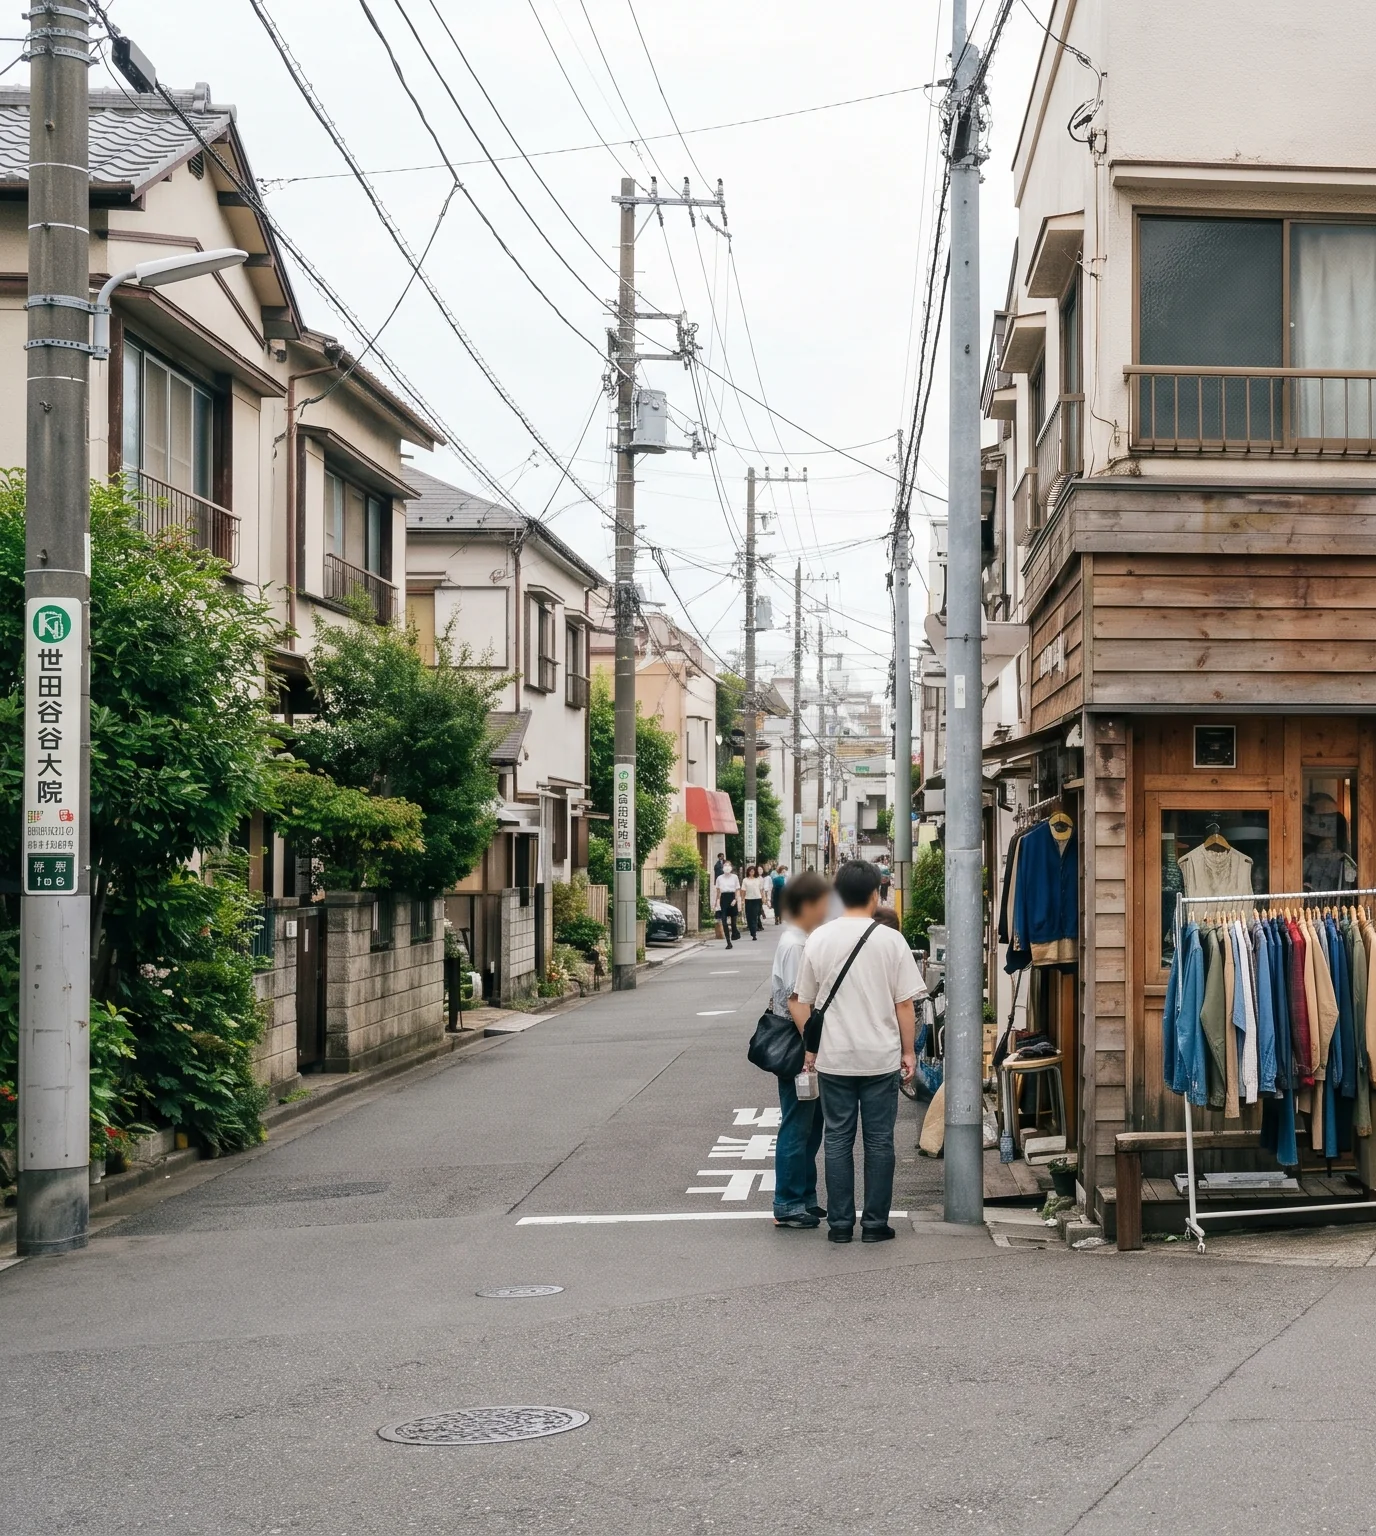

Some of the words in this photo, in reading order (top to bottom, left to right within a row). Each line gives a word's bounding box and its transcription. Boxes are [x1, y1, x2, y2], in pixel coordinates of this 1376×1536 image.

[37, 648, 63, 805] 世田谷谷大院
